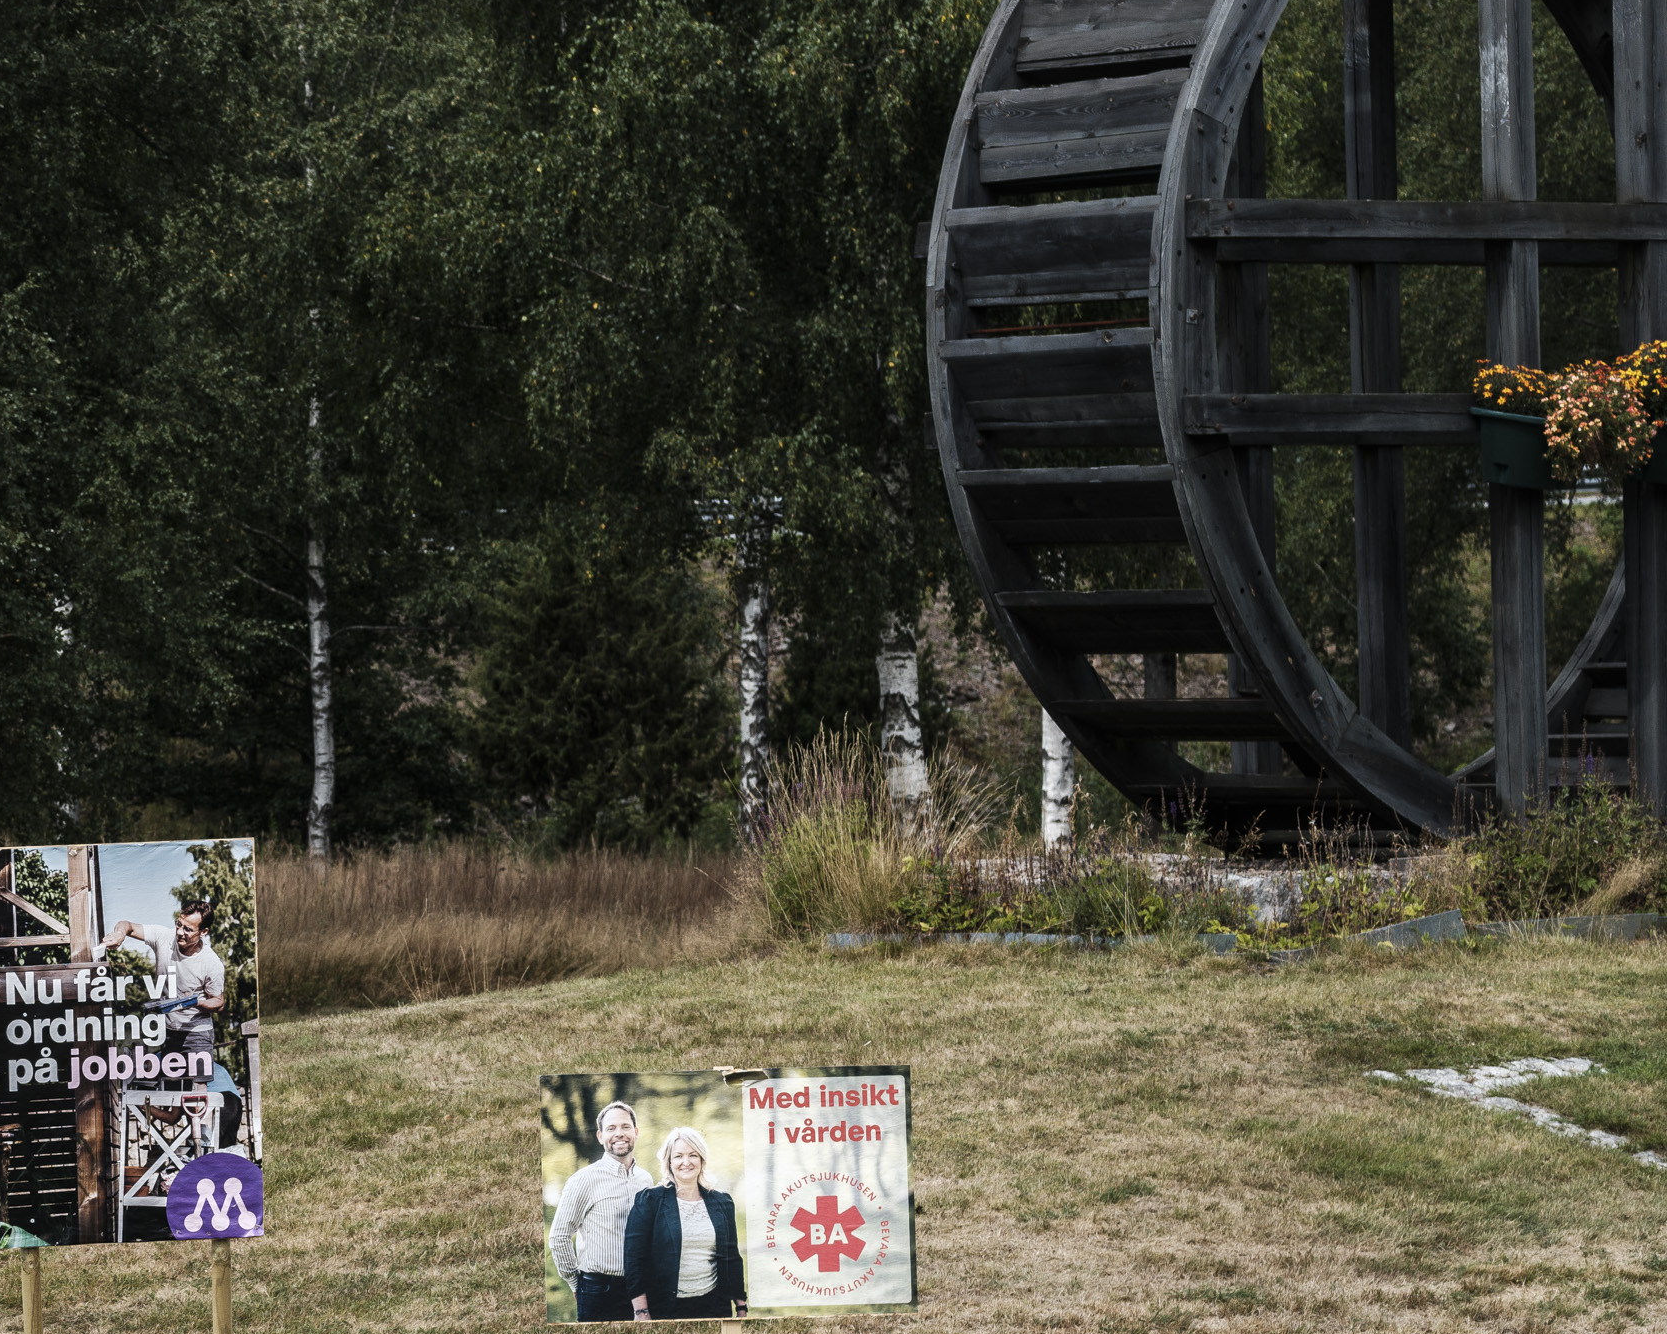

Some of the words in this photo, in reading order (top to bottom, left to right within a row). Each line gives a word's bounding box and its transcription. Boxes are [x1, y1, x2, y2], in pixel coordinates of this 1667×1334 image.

[5, 971, 63, 1006] Nu
[73, 966, 134, 1003] får
[142, 965, 178, 1000] vi
[5, 1007, 167, 1047] ordning
[8, 1047, 59, 1092] på
[67, 1045, 213, 1090] jobben
[749, 1086, 810, 1110] Med
[819, 1083, 900, 1108] insikt
[768, 1121, 776, 1144] i
[784, 1118, 882, 1144] vården
[767, 1202, 783, 1249] BEVARA
[781, 1171, 877, 1202] AKUTSJUKHUSEN
[810, 1223, 849, 1246] BA
[873, 1220, 890, 1266] BEVARA
[778, 1266, 875, 1297] AKUTSJUKHUSEN
